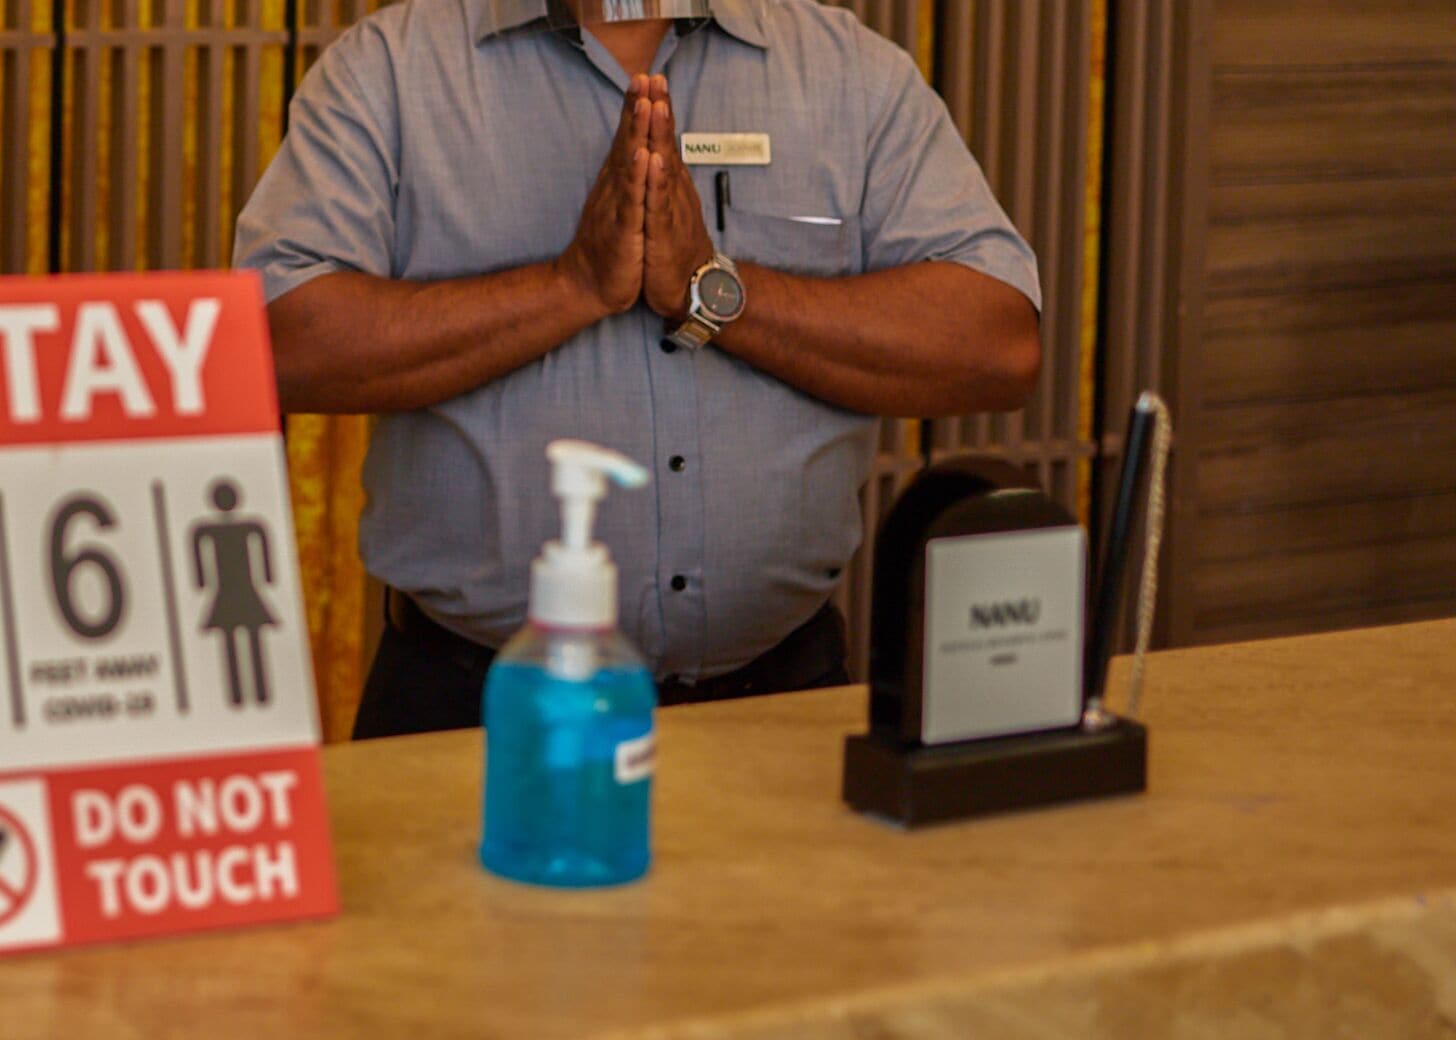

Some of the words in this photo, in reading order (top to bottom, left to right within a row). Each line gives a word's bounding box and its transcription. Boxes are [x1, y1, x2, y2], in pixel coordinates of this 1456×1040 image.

[684, 143, 721, 153] NANU
[47, 492, 128, 640] 6
[970, 598, 1041, 629] NANU
[31, 658, 87, 683] FEET
[95, 655, 160, 680] AWAY
[71, 784, 162, 848] DO
[173, 770, 298, 838] NOT
[86, 842, 299, 918] TOUCH
